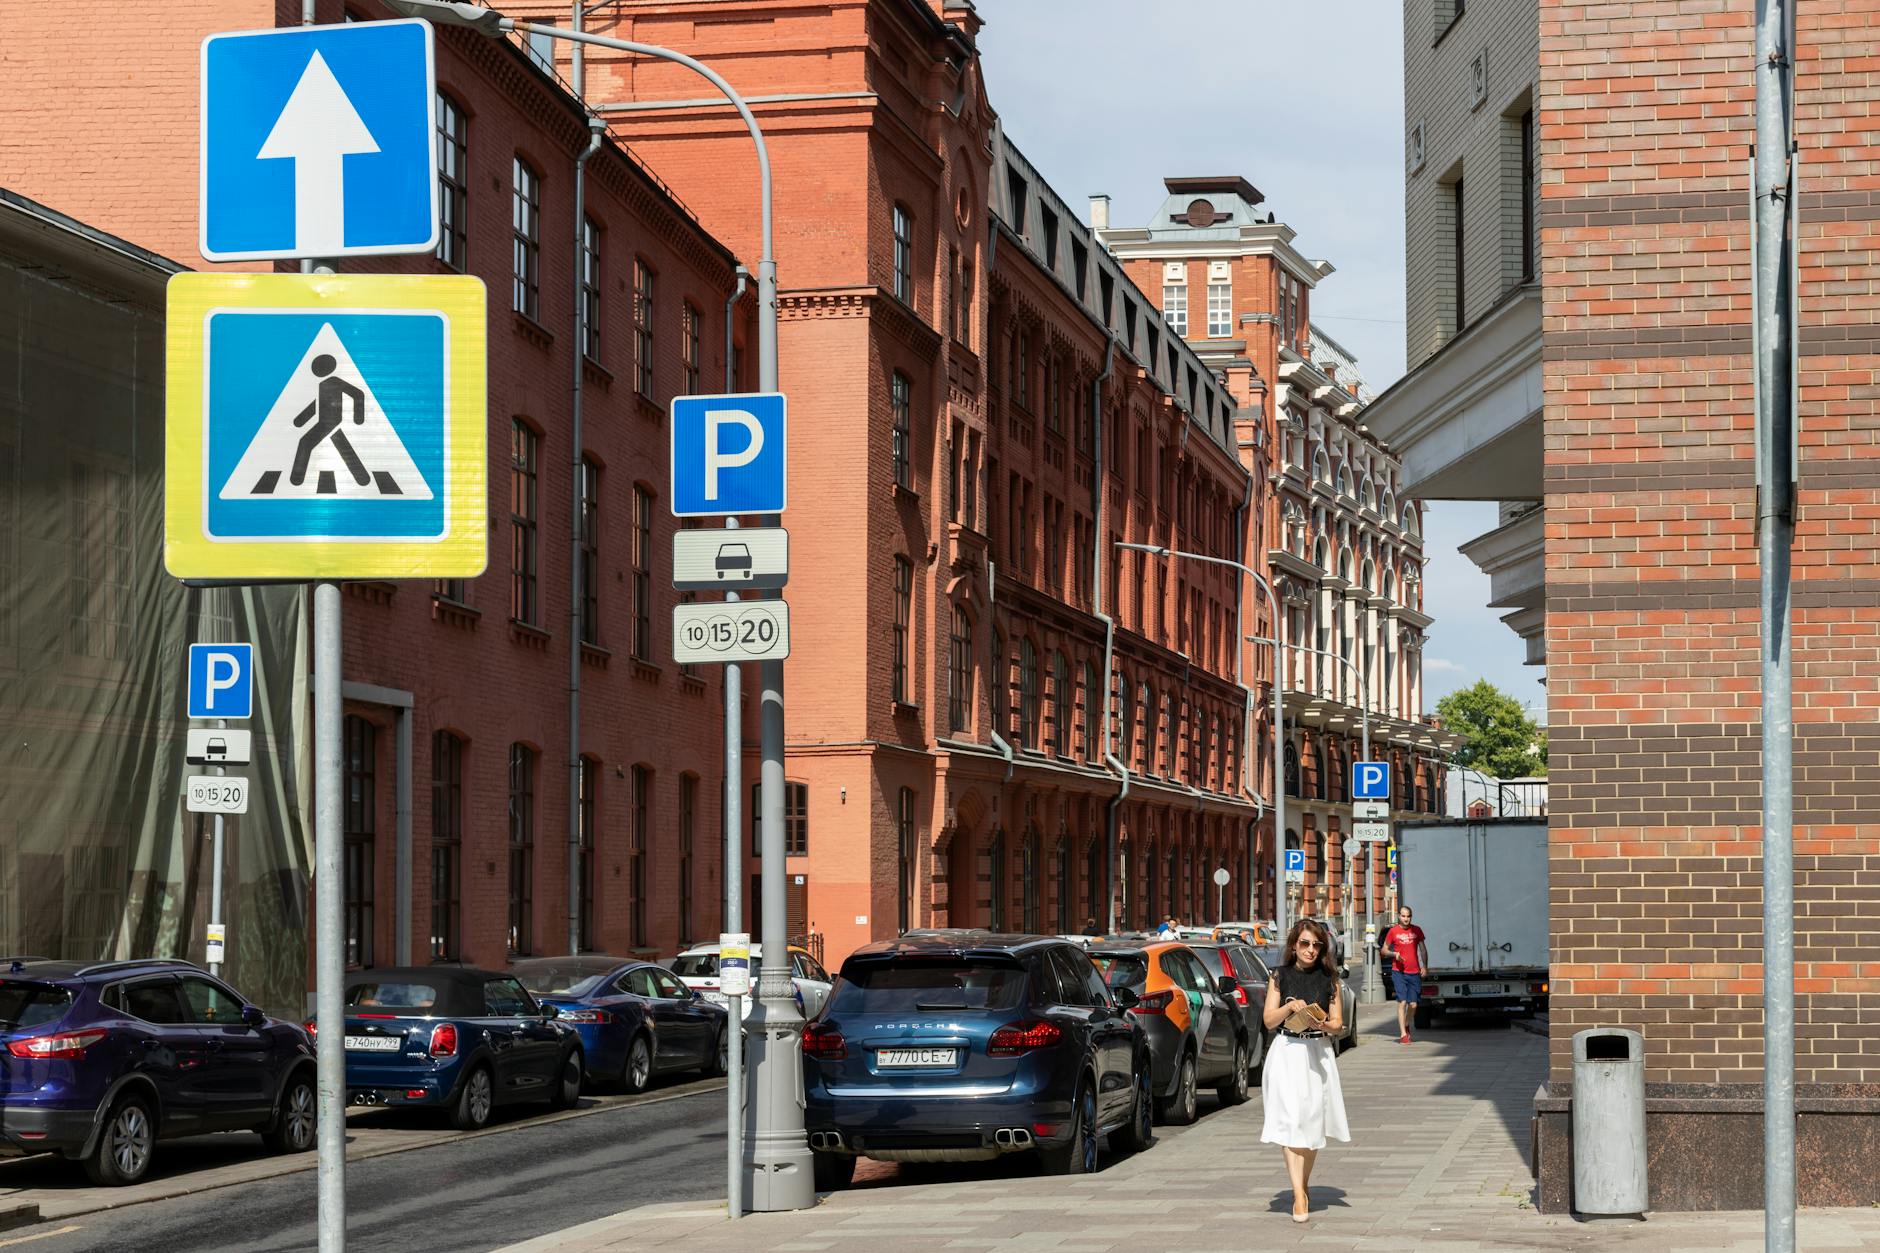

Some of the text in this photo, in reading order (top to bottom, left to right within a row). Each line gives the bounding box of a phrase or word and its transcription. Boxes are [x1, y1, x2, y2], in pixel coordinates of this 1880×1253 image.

[705, 409, 764, 500] P
[687, 619, 774, 643] 10 15 20
[206, 653, 240, 709] P
[1363, 766, 1382, 794] P
[195, 787, 241, 802] 10 15 20
[1374, 829, 1384, 837] 20
[1289, 852, 1301, 868] P
